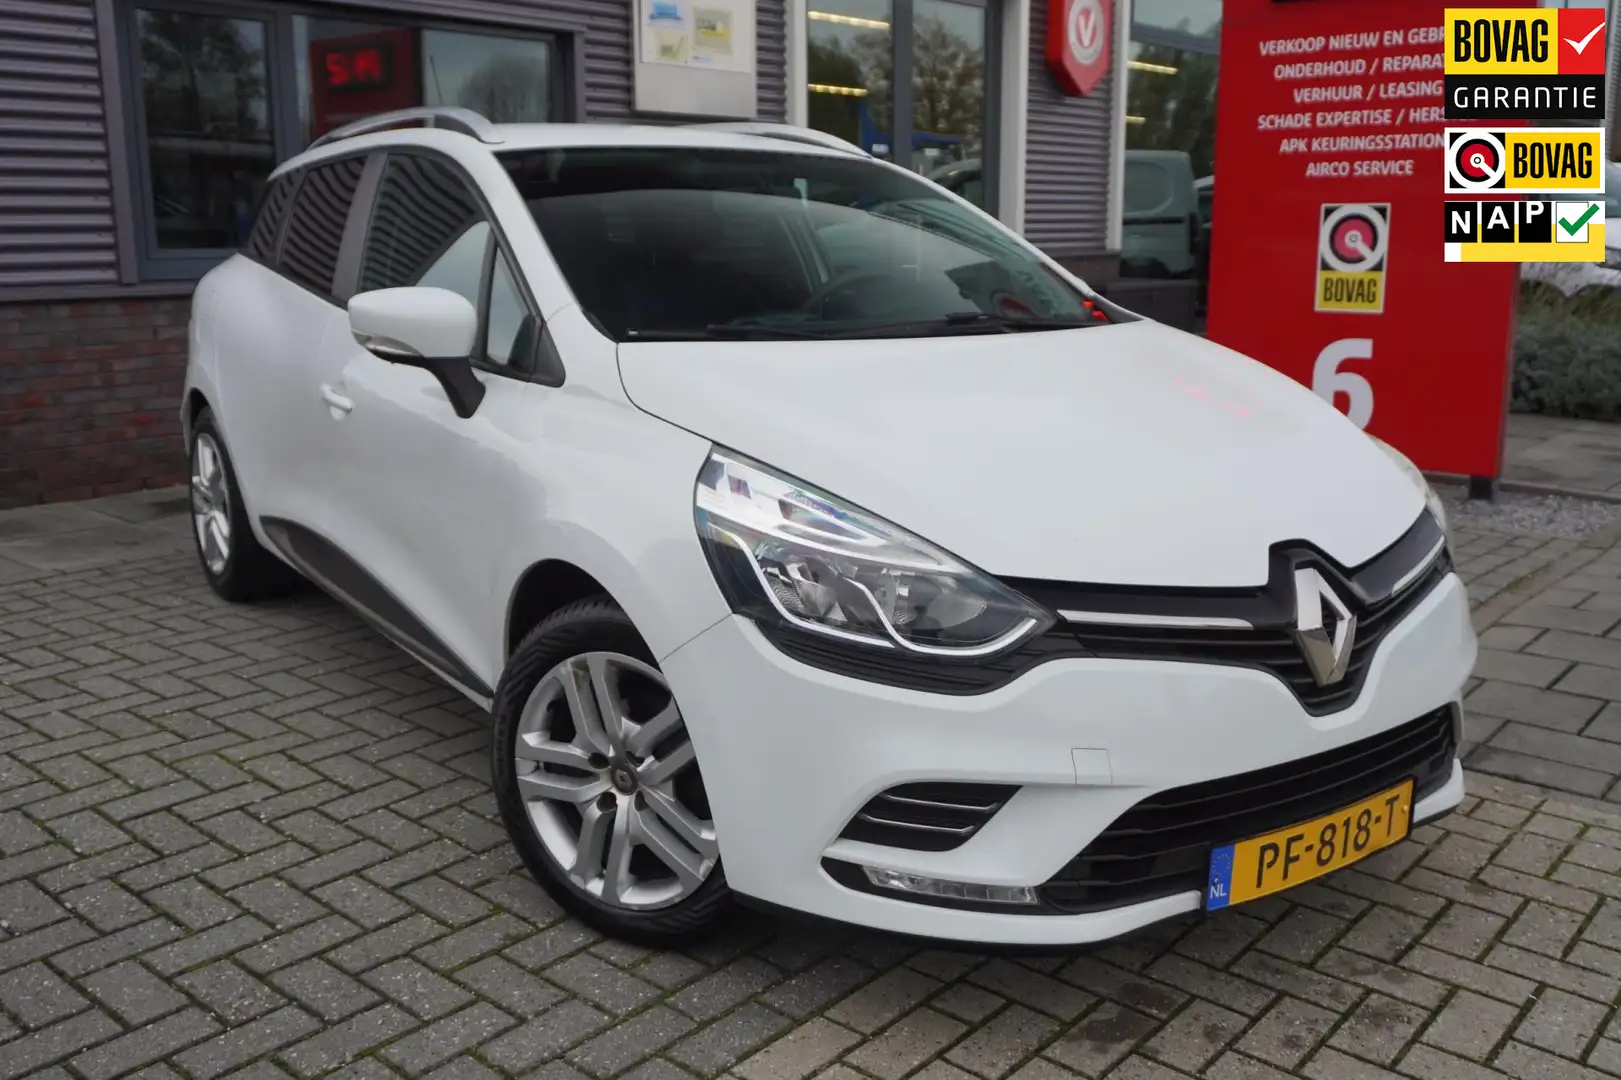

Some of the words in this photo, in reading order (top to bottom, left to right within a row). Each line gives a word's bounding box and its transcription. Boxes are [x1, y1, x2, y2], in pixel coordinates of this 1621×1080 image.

[1259, 36, 1325, 56] VERKOOP
[1329, 32, 1380, 50] NIEUW
[1383, 30, 1403, 47] EN
[1274, 59, 1366, 80] ONDERHOUD
[1382, 53, 1444, 72] REPARA
[1293, 85, 1363, 103] VERHUUR
[1379, 80, 1443, 98] LEASING
[1257, 113, 1312, 131] SCHADE
[1316, 109, 1392, 127] EXPERTISE
[1279, 138, 1308, 154] APK
[1311, 133, 1444, 152] KEURINGSSTATION
[1305, 161, 1349, 177] AIRCO
[1353, 159, 1414, 176] SERVICE
[1323, 277, 1378, 304] BOVAG
[1312, 338, 1374, 430] 6
[1256, 794, 1400, 888] PF-818-T
[1210, 882, 1228, 900] NL
